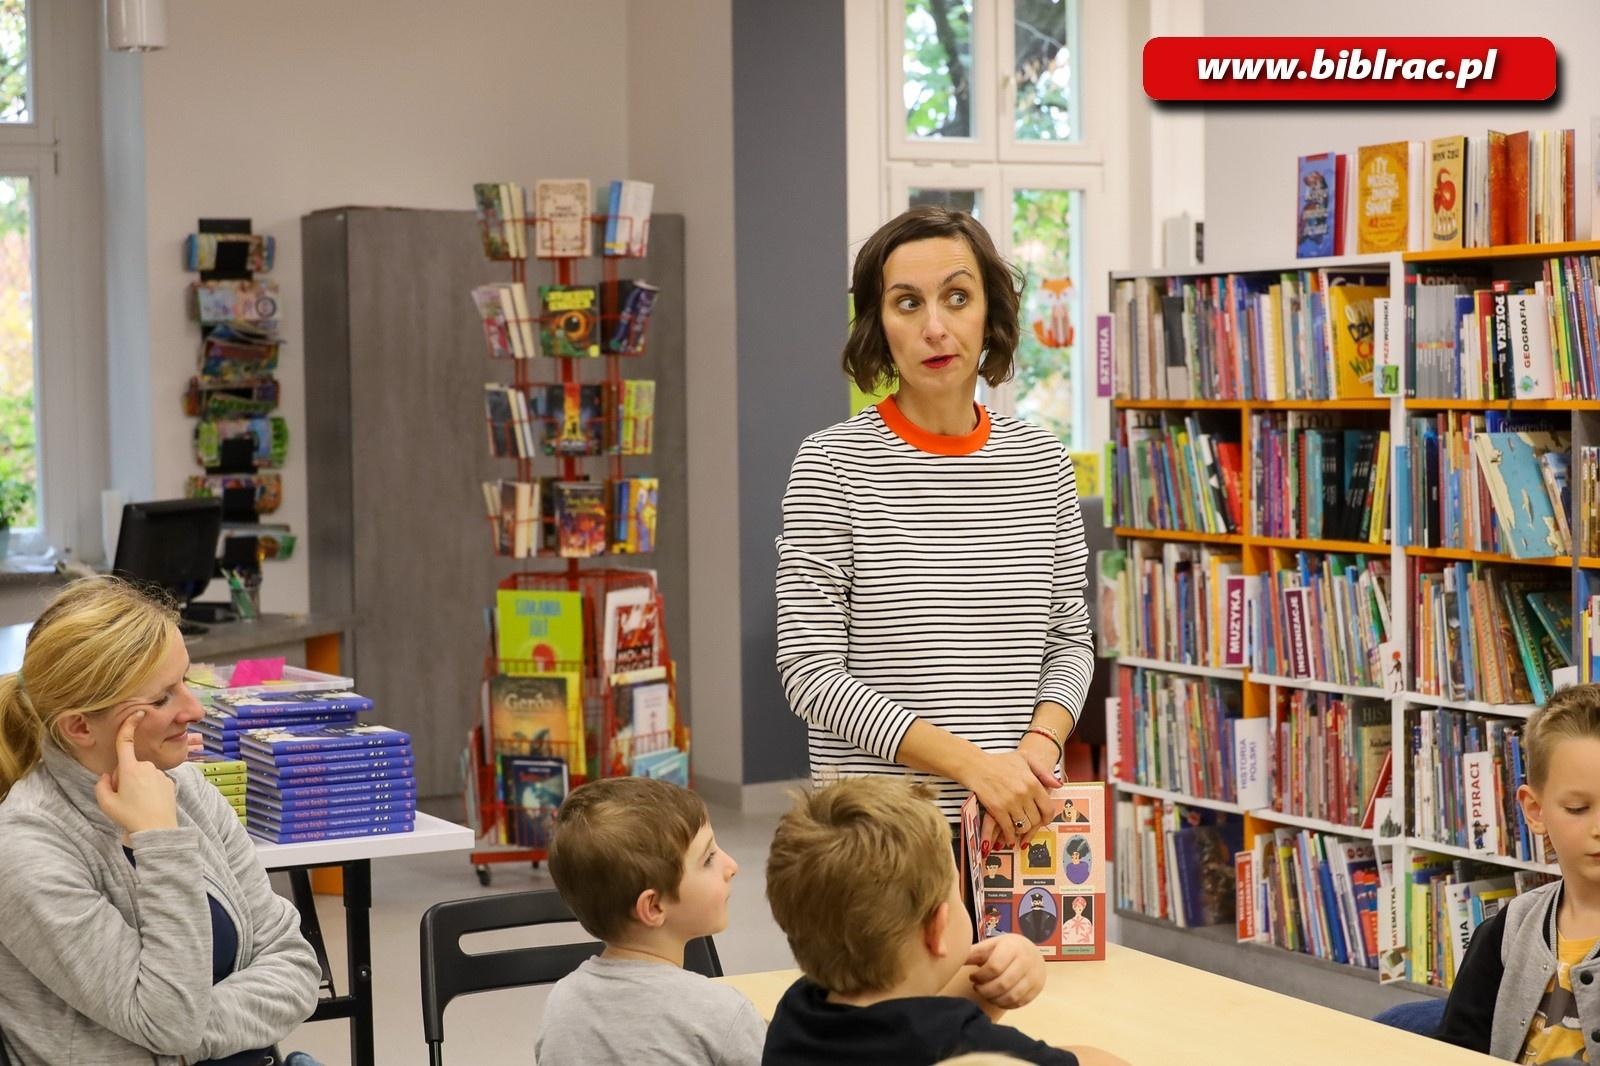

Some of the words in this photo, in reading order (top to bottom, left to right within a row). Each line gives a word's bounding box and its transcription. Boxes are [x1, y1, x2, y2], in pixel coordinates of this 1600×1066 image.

[1495, 296, 1507, 350] POLSKA
[1518, 299, 1531, 368] GEOGRAFIA
[1100, 327, 1110, 385] SZTUKA
[1229, 588, 1241, 654] MUZYKA
[1290, 596, 1305, 672] INSCENIZACJE
[1471, 762, 1482, 818] PIRACI
